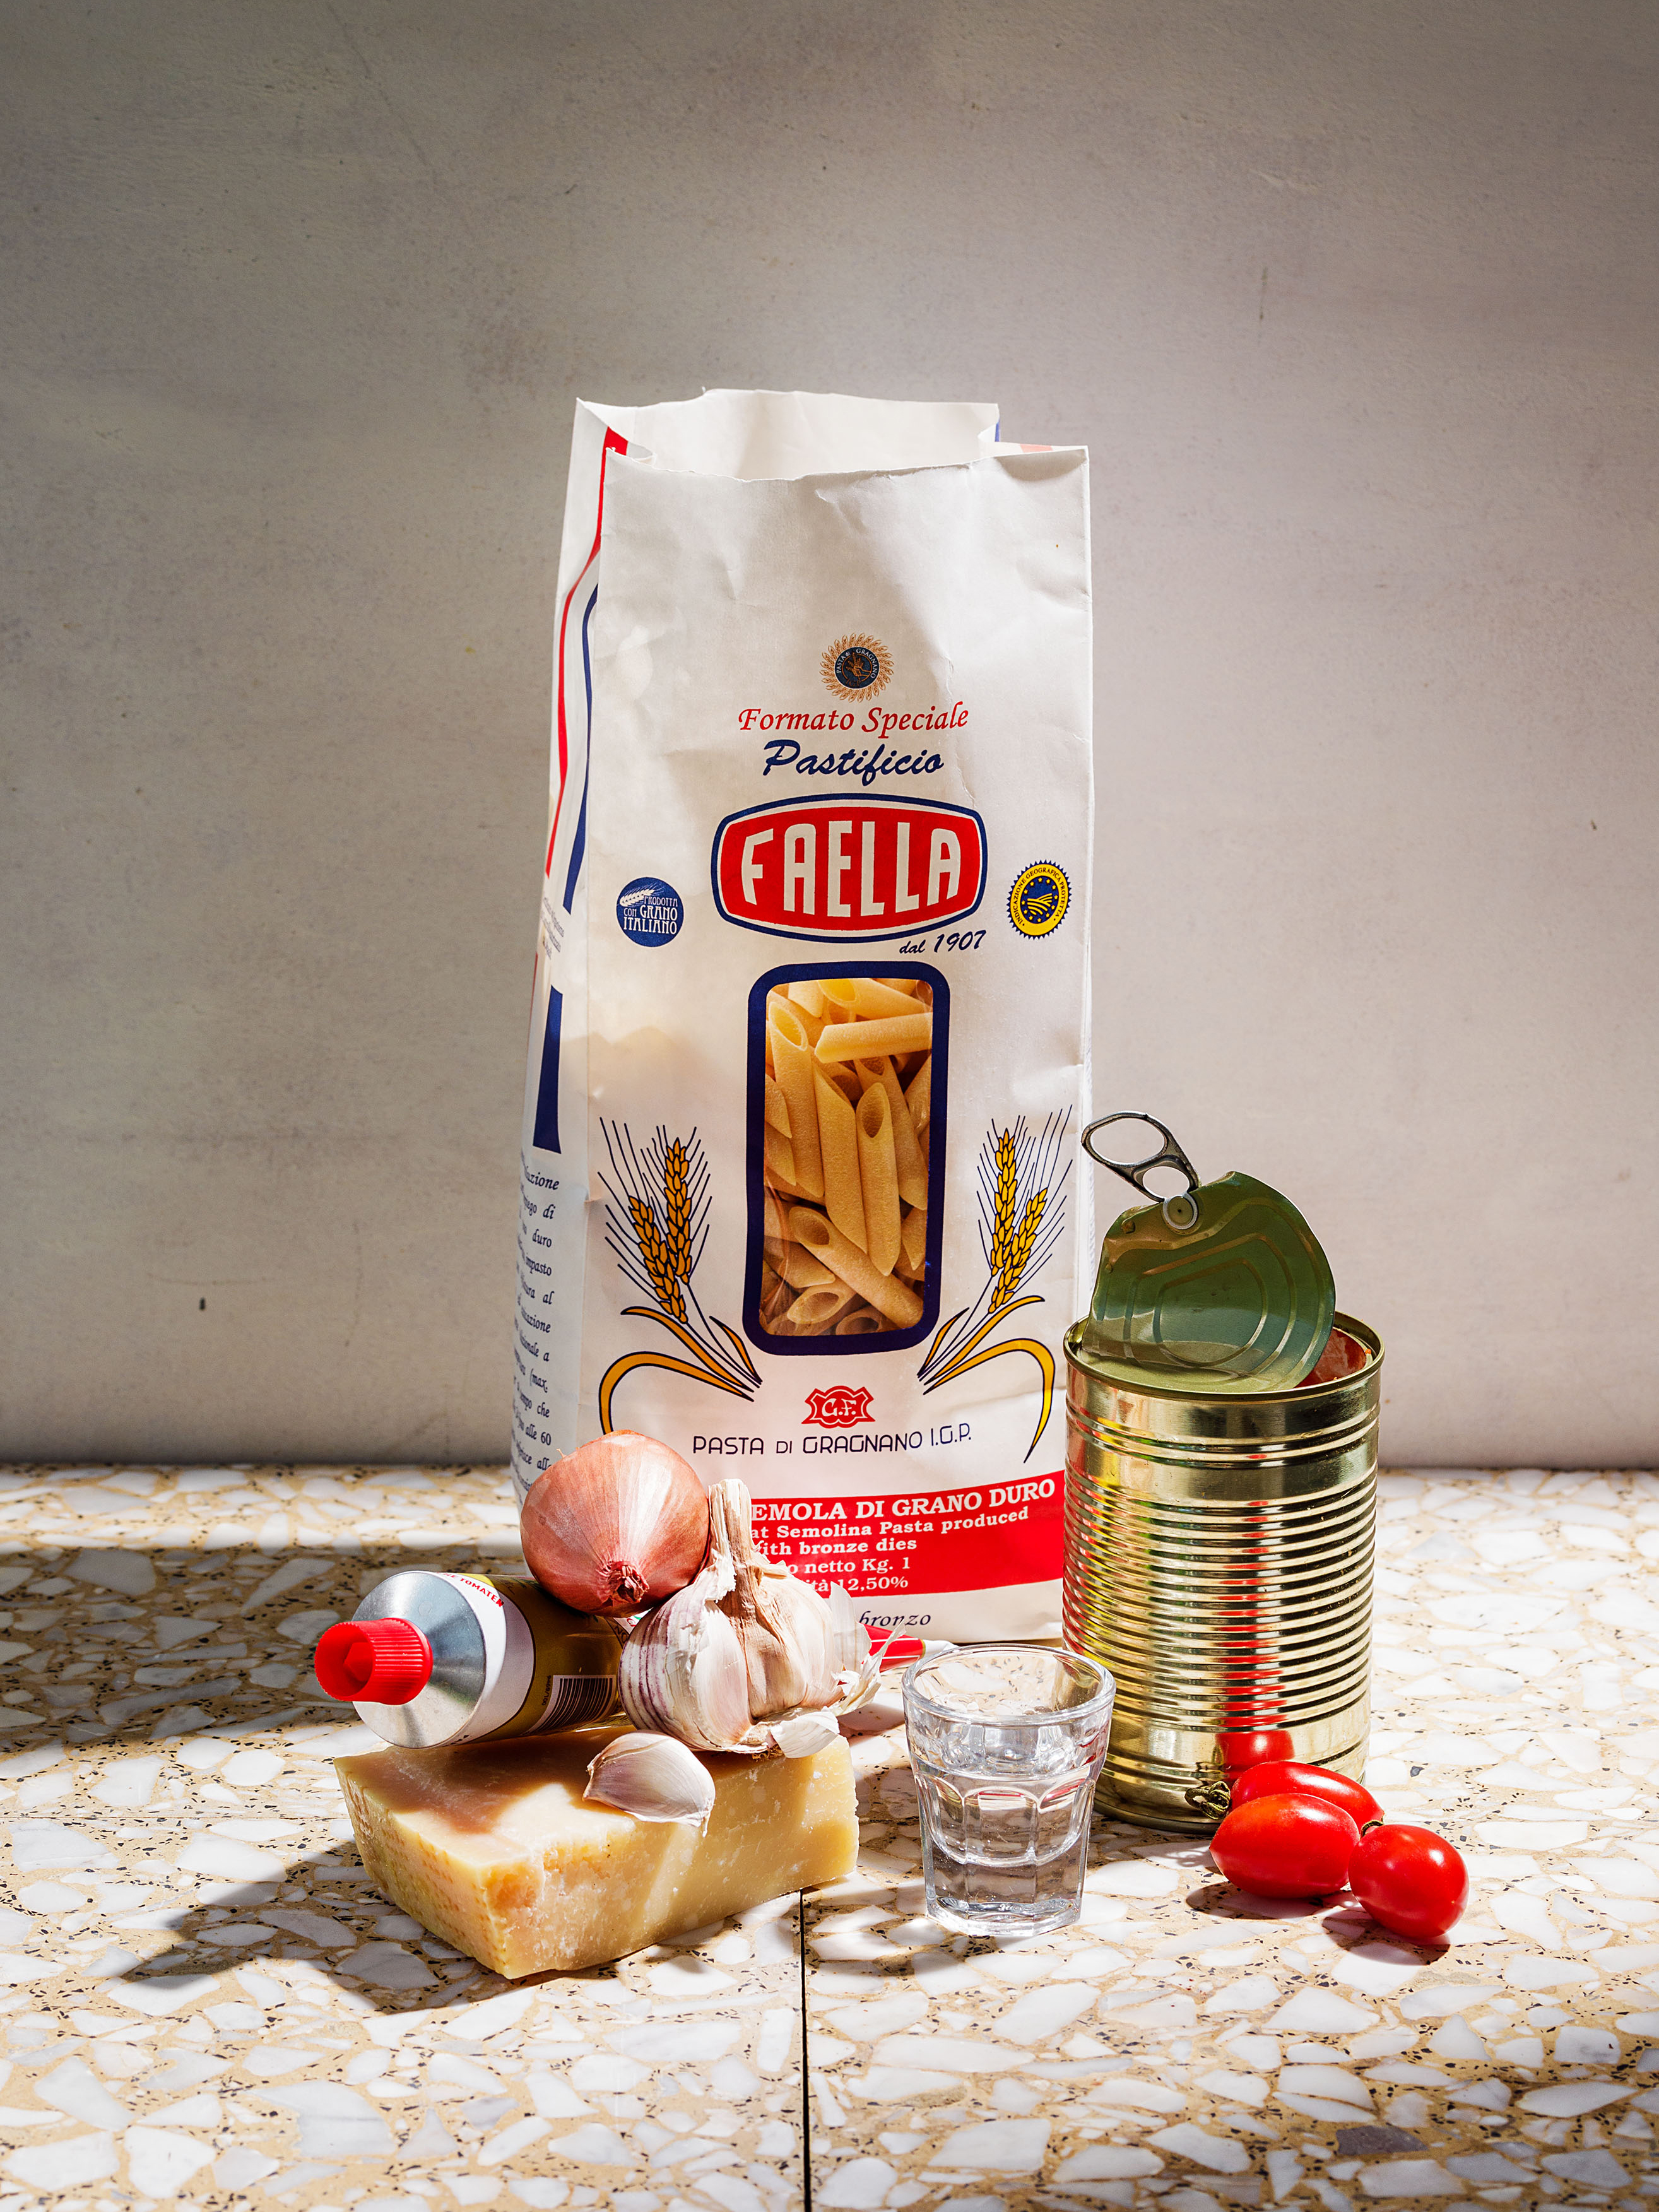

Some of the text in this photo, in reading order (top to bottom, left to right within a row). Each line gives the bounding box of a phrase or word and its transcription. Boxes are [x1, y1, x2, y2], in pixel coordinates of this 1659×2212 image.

[836, 655, 846, 673] PASTA
[856, 648, 878, 678] GRAGNANO
[738, 701, 969, 739] Formato Speciale
[762, 739, 945, 787] Pastificio
[741, 820, 961, 918] FAELLA
[644, 896, 678, 907] PRODOTTA
[1013, 867, 1066, 925] INDICAZIONE GEOGRAFICA PROTETTA
[623, 904, 678, 921] CON GRANO
[623, 916, 677, 935] ITALIANO
[899, 930, 987, 955] dal 1907
[542, 1204, 556, 1219] di
[532, 1228, 552, 1248] duro
[542, 1291, 555, 1305] al
[543, 1352, 550, 1362] a
[537, 1402, 550, 1418] che
[540, 1431, 552, 1446] 60
[693, 1422, 972, 1455] PASTA DI GRAGNANO I.G.P.
[751, 1479, 1055, 1521] EMOLA DI GRANO DURO
[776, 1523, 872, 1538] Semolina
[879, 1520, 934, 1534] Pasta
[940, 1506, 1029, 1534] produced
[799, 1541, 868, 1554] bronze
[876, 1537, 918, 1551] dies
[805, 1559, 856, 1573] netto
[861, 1558, 894, 1574] Kg.
[902, 1557, 911, 1570] 1
[460, 1578, 505, 1607] TOMATEN
[859, 1611, 933, 1627] bronzo
